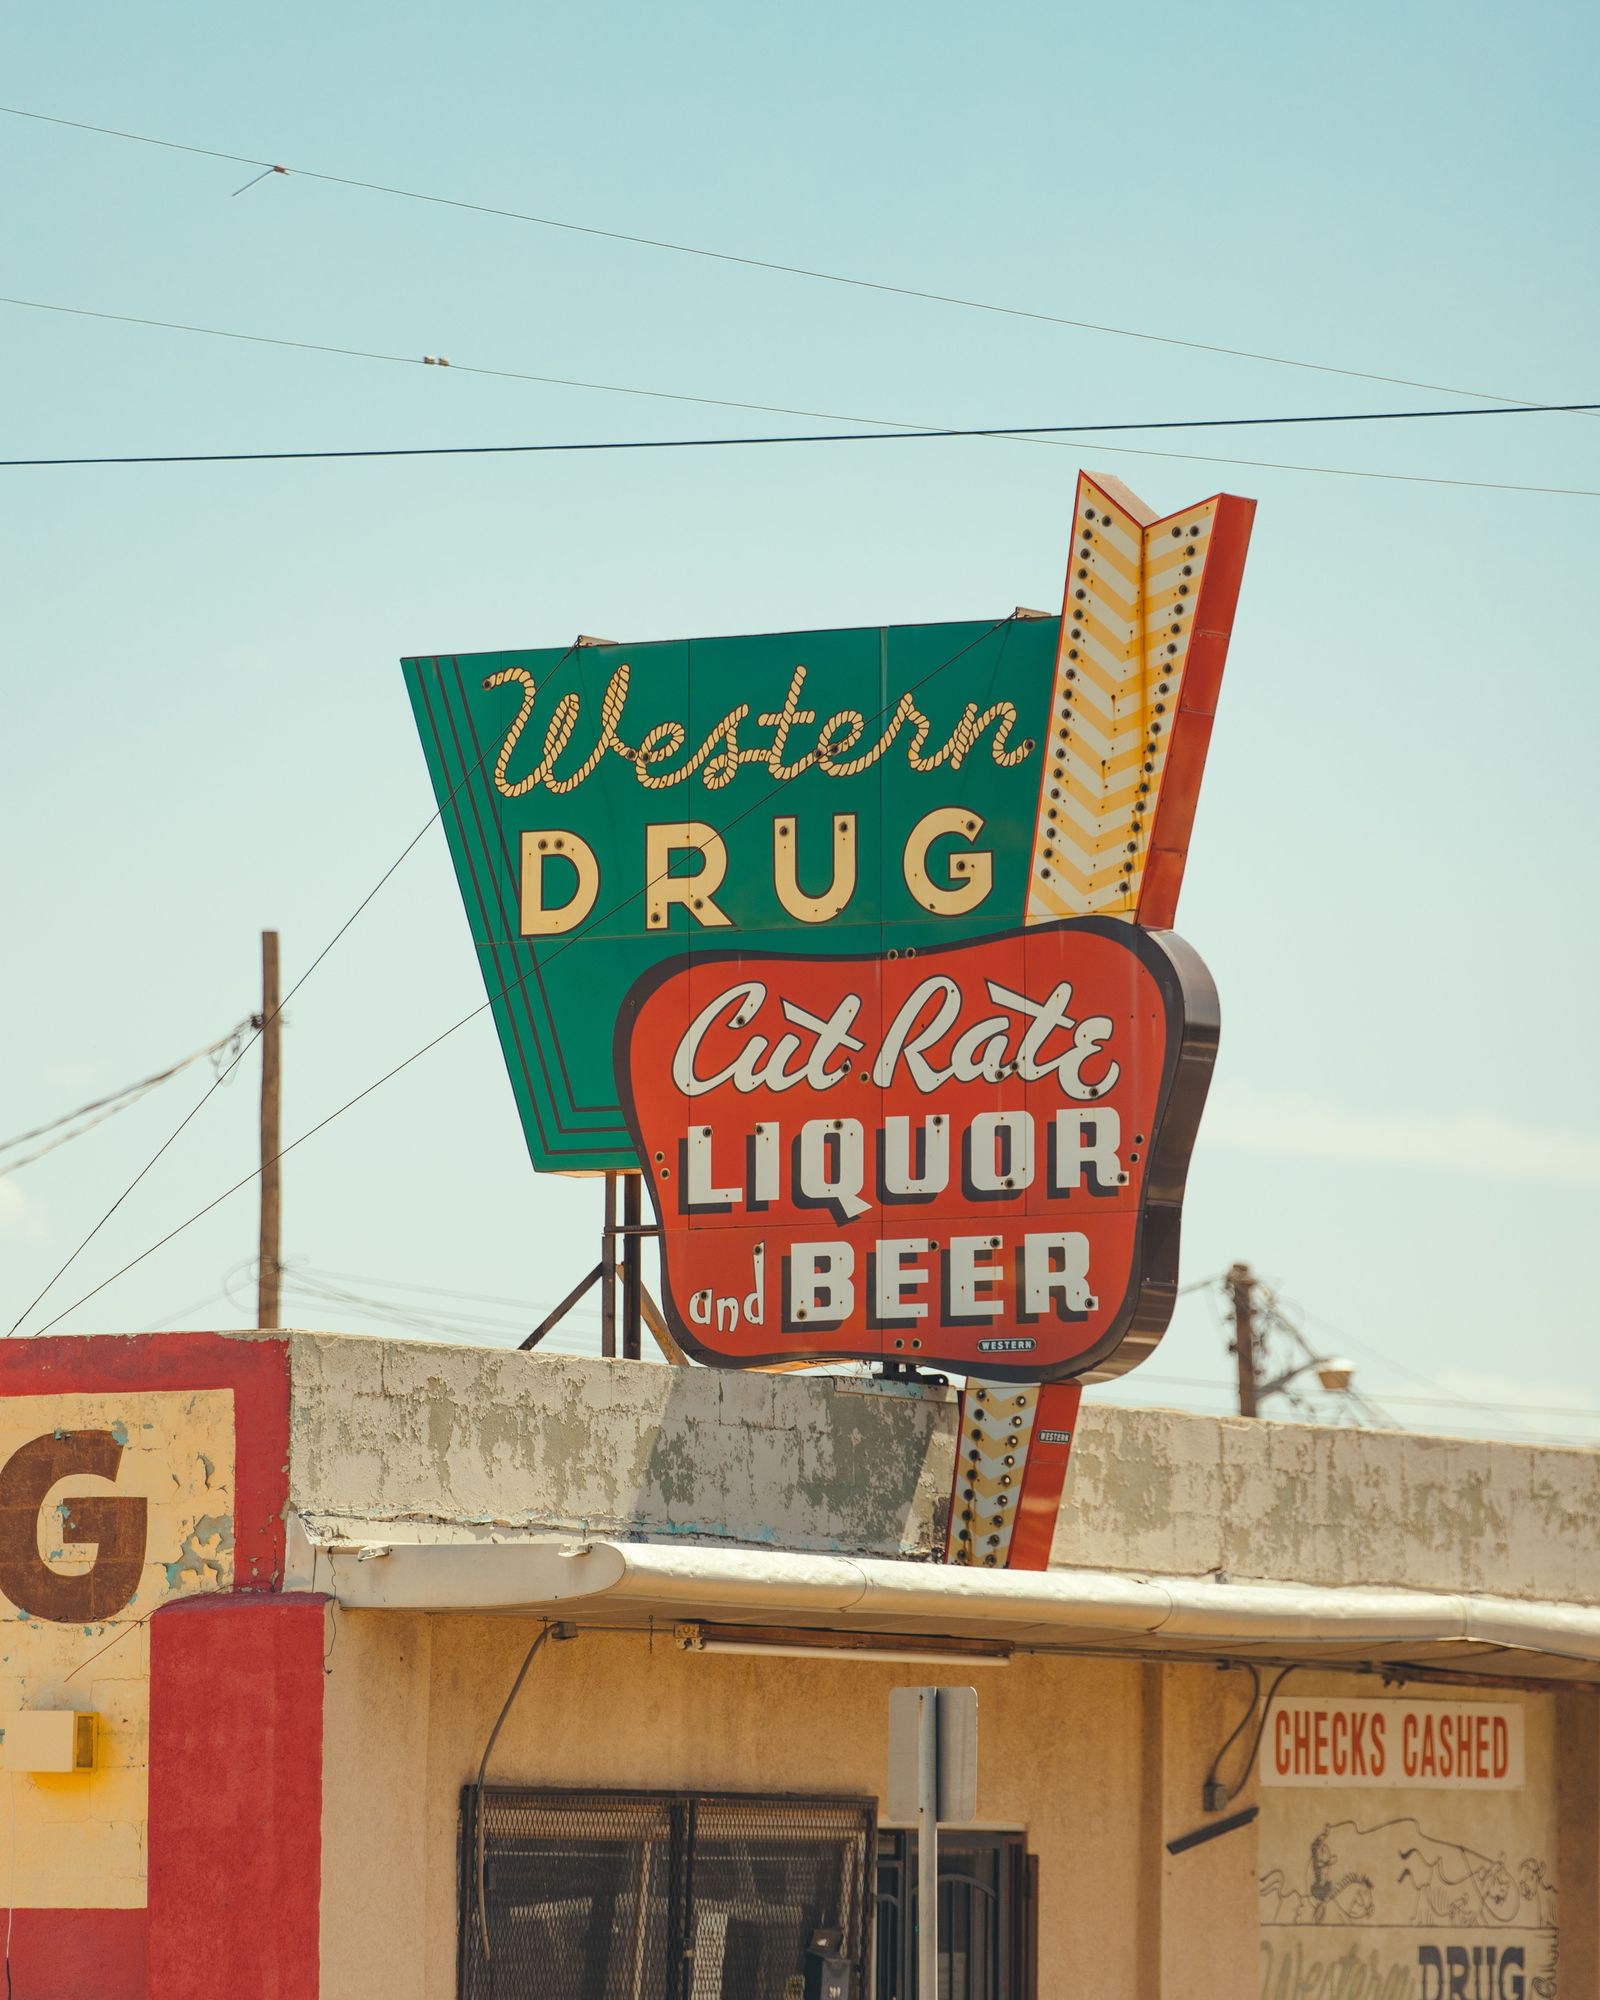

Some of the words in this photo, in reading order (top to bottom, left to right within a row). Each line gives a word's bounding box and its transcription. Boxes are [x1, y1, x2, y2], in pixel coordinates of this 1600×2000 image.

[482, 664, 1035, 796] Western
[518, 806, 993, 937] DRUG
[671, 981, 866, 1096] Cut
[871, 974, 1121, 1101] Rate
[684, 1107, 1129, 1222] LIQUOR
[688, 1240, 766, 1333] and
[786, 1232, 1098, 1326] BEER
[981, 1341, 1032, 1350] WESTERN
[1040, 1432, 1069, 1441] WESTERN
[0, 1429, 148, 1624] G
[1275, 1709, 1386, 1777] CHECKS
[1403, 1713, 1509, 1779] CASHED
[1418, 1945, 1526, 2000] DRUG
